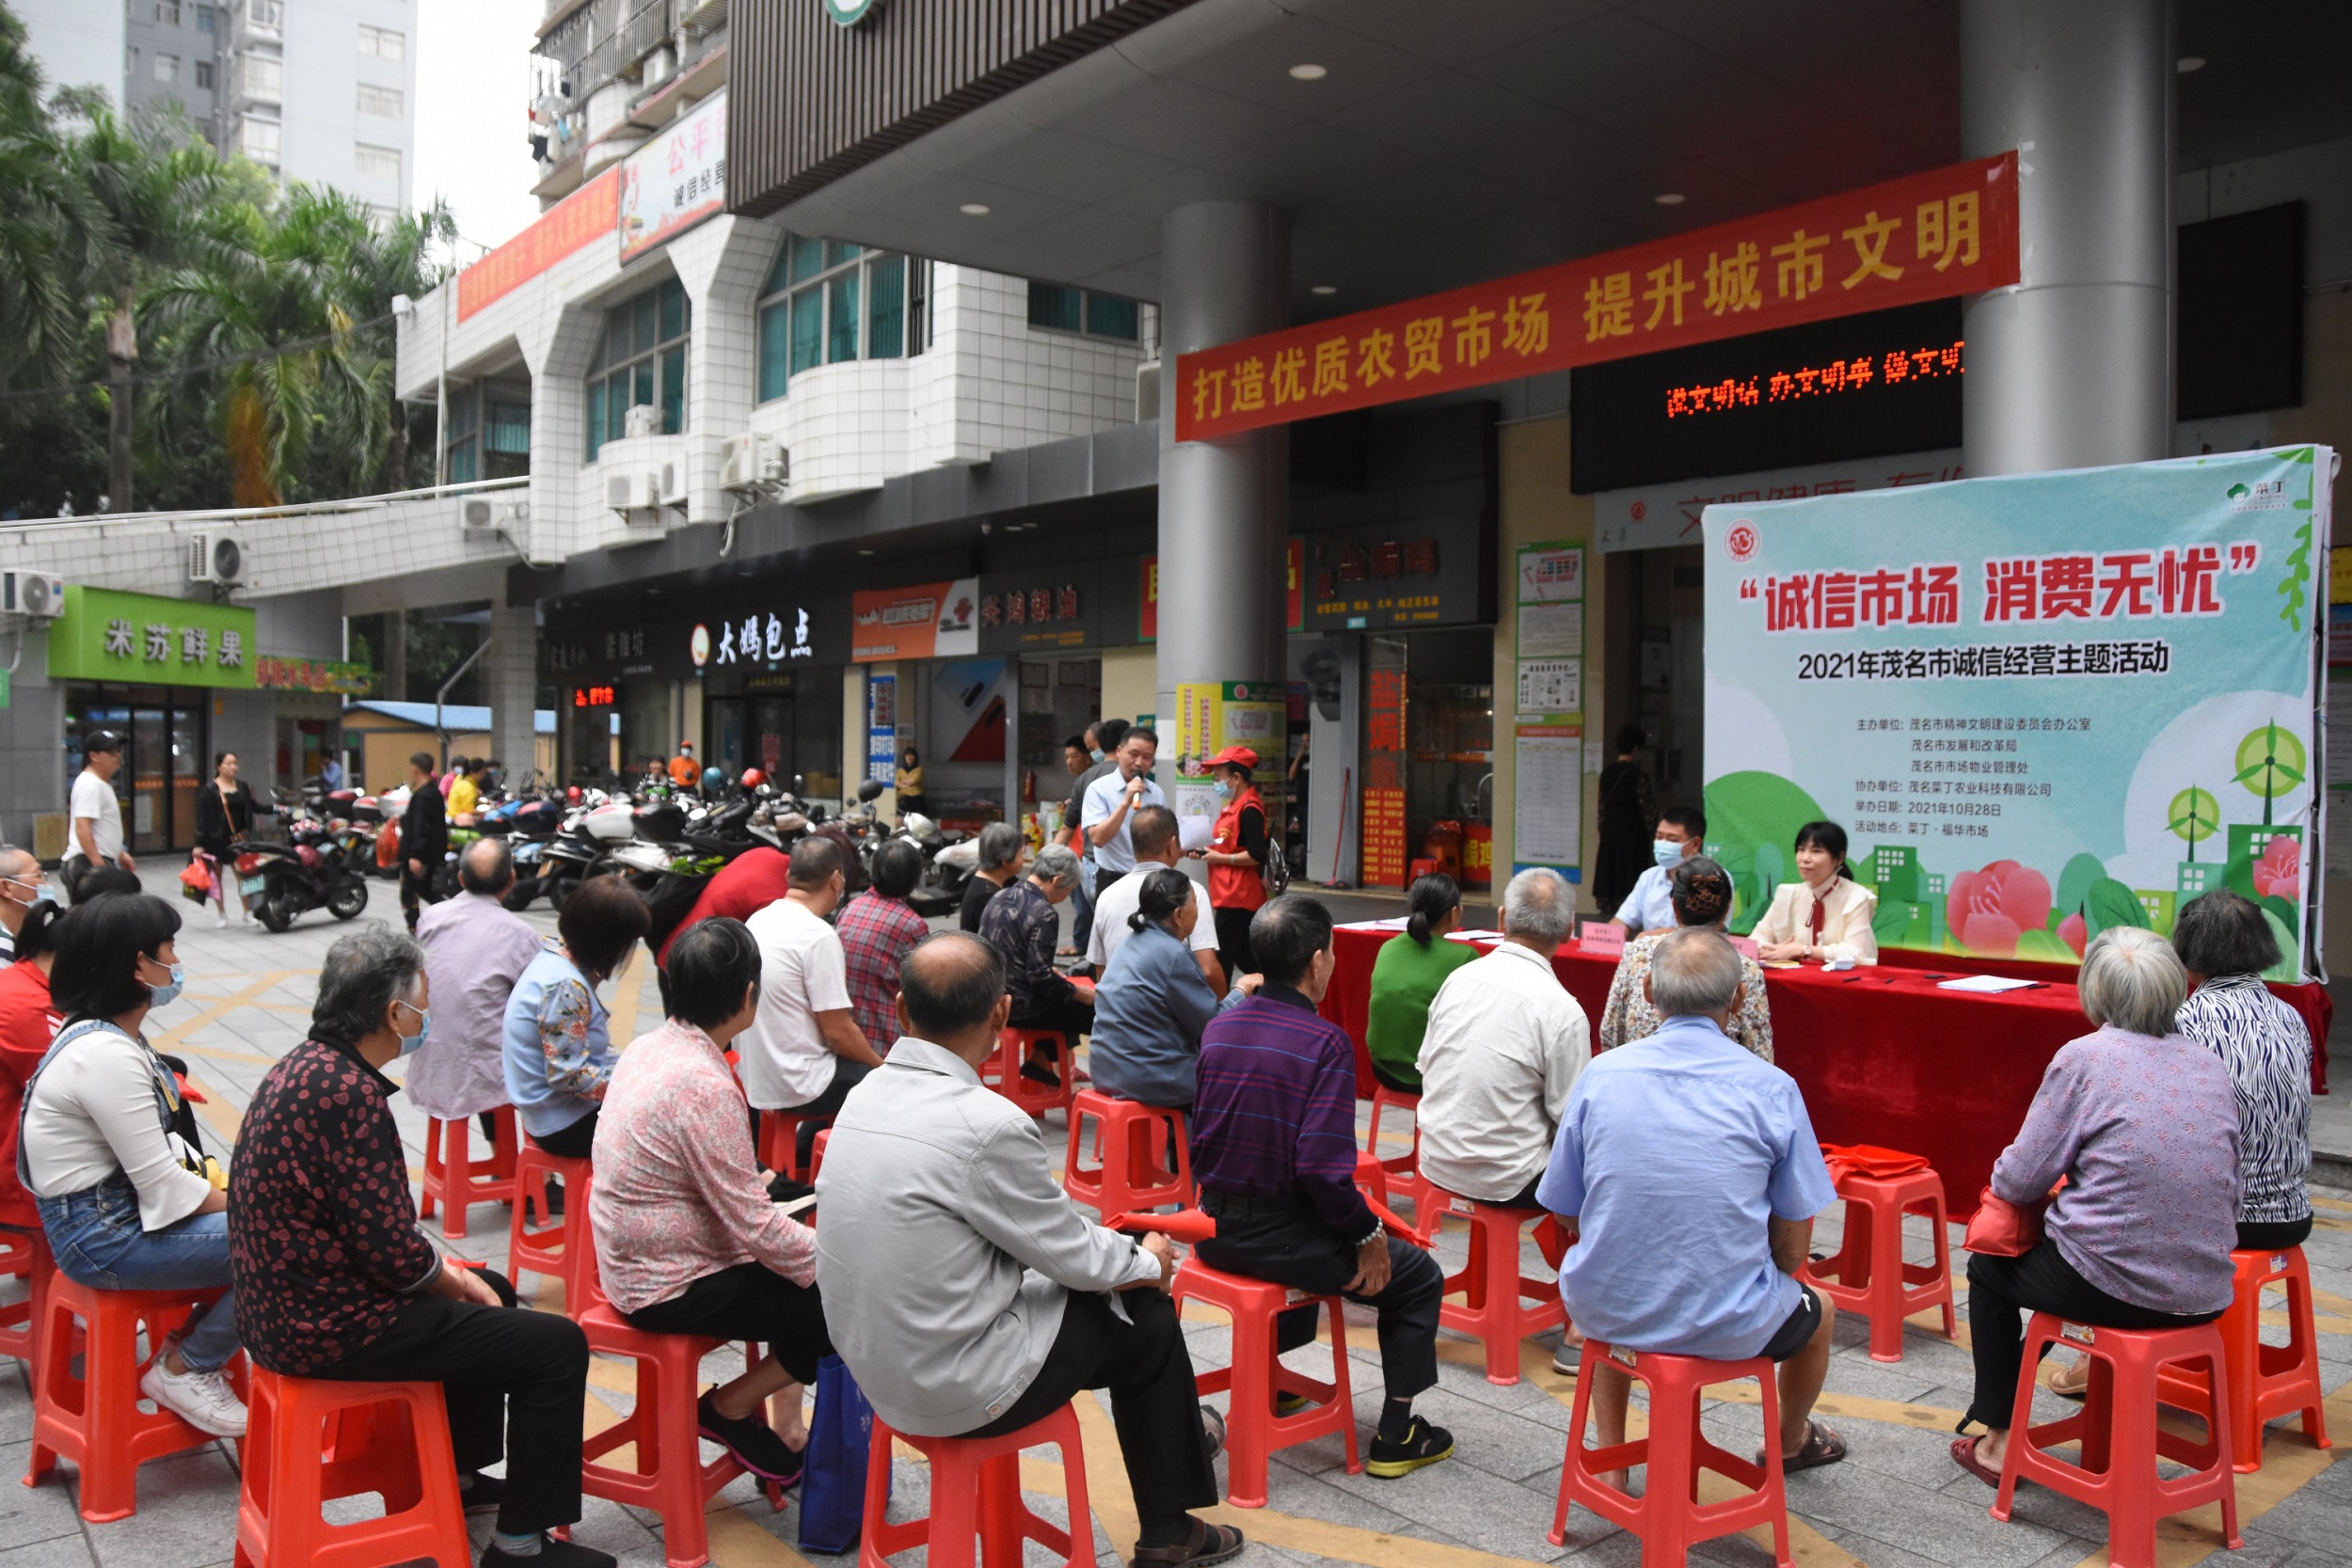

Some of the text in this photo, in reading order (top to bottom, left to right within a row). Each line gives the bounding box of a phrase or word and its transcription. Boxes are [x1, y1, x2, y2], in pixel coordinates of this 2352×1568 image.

[1193, 190, 1981, 421] 打造优质农贸市场 提升城市文明
[1768, 356, 1874, 403] 办文明事
[2256, 480, 2288, 495] 菜丁
[1739, 544, 2257, 632] “诚信市场 消费无忧”
[105, 618, 243, 667] 米苏鲜果
[1797, 640, 2169, 681] 2021年茂名市诚信经营主题活动
[1910, 759, 2030, 775] 茂名市市场物业管理处
[1911, 738, 2018, 752] 茂名市发展和改革局
